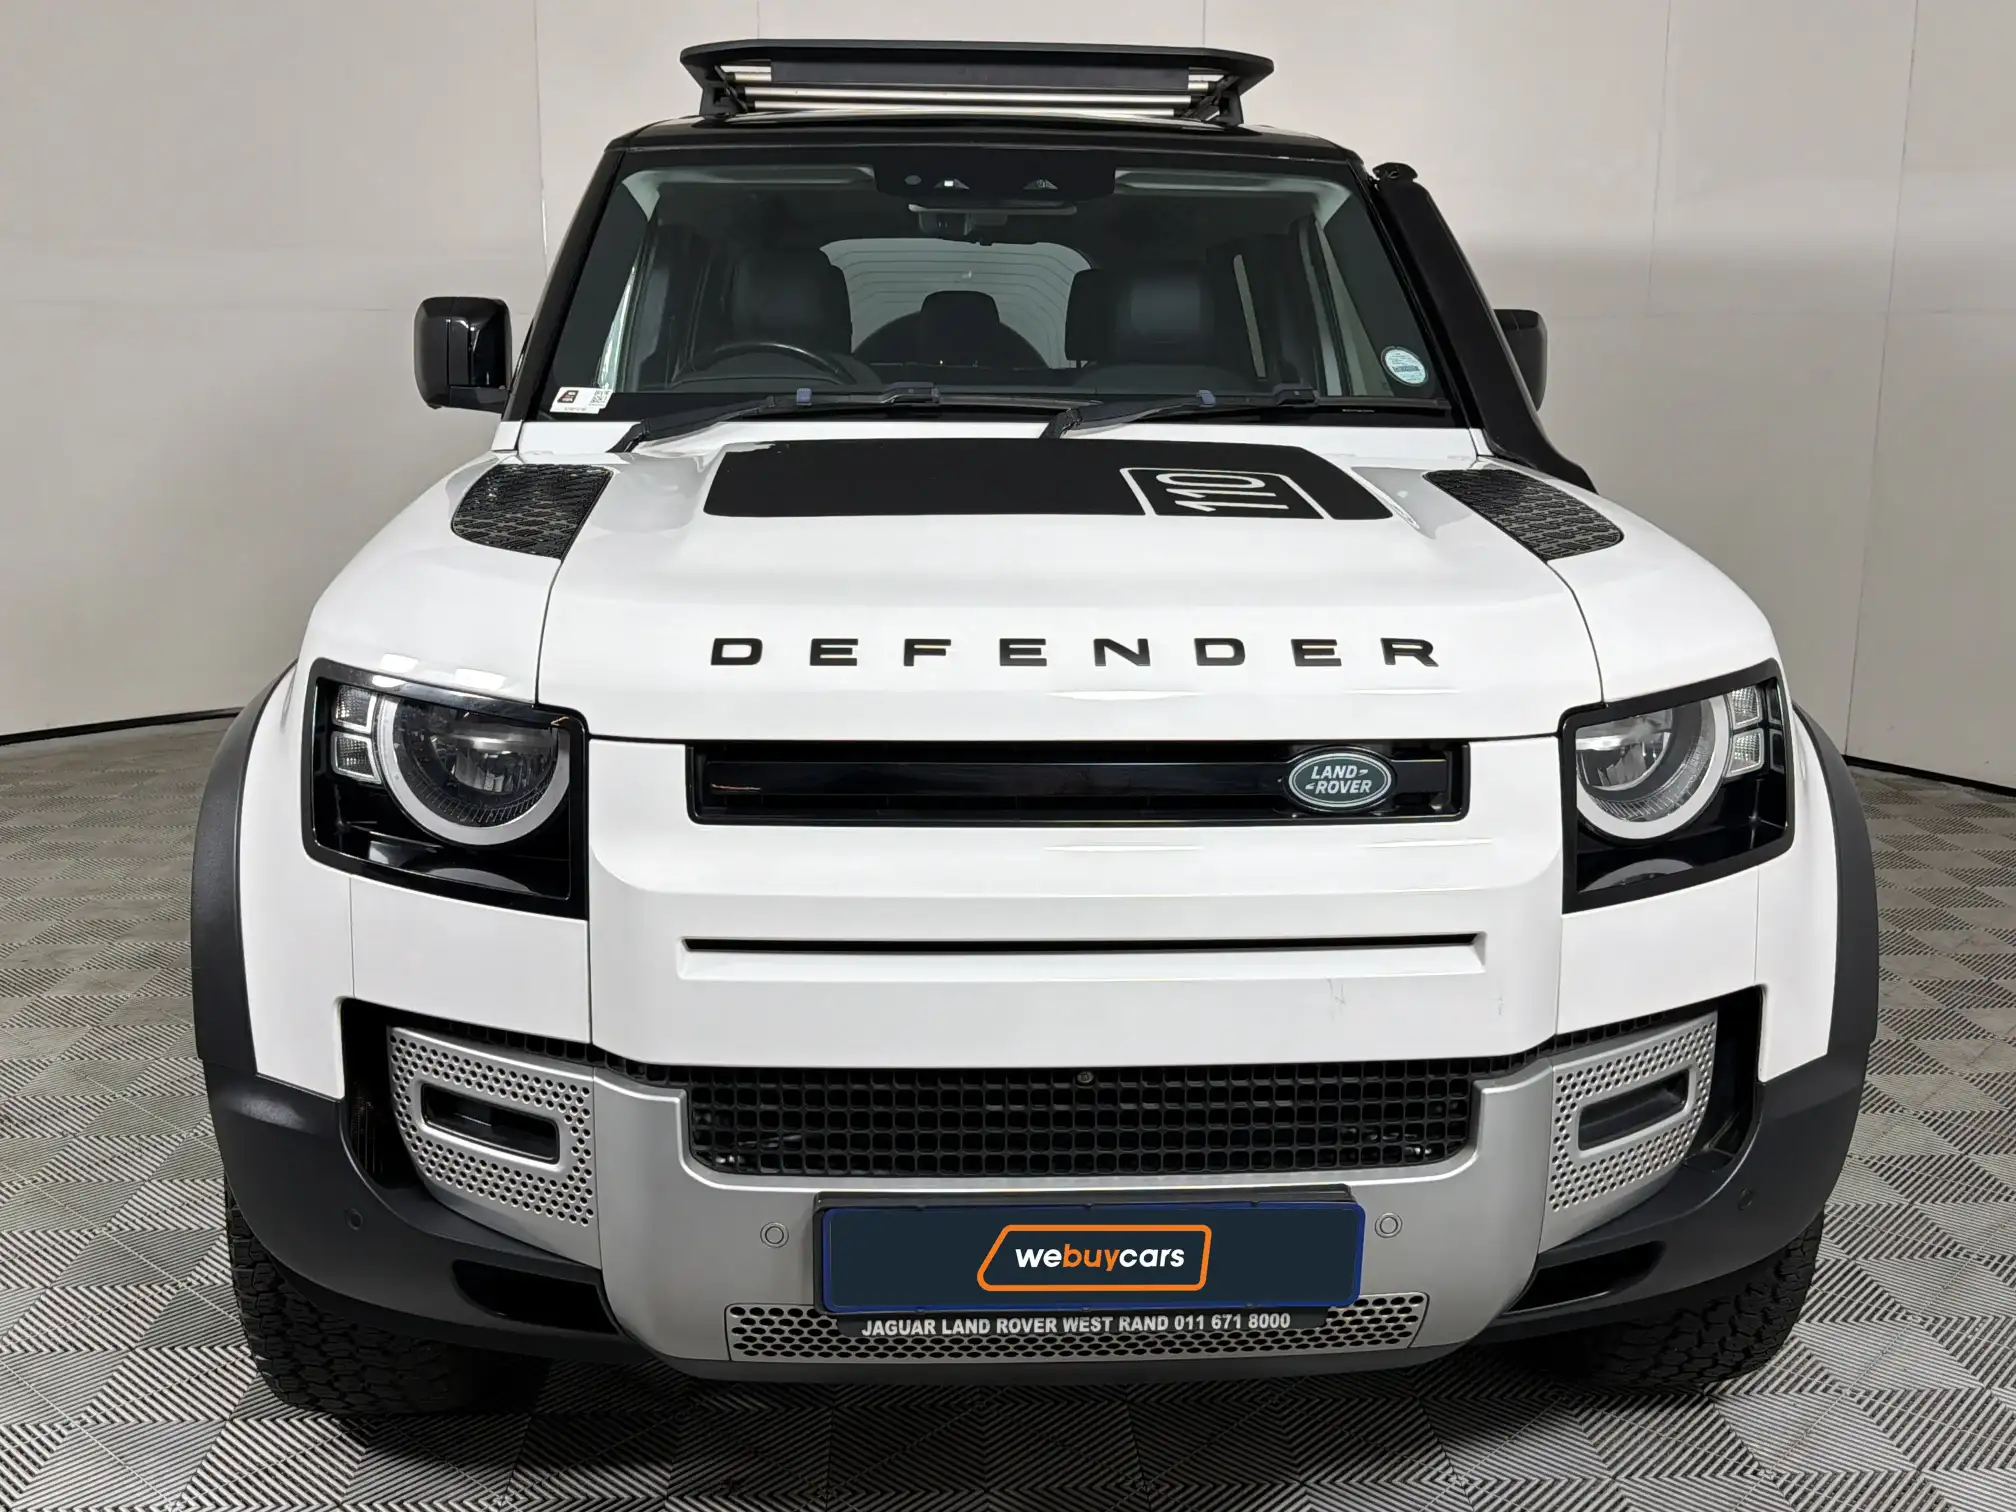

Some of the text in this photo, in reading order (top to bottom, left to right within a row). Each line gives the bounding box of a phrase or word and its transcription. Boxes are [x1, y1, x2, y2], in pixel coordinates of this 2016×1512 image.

[1155, 472, 1290, 512] 110
[710, 637, 1439, 668] DEFENDER
[1310, 765, 1358, 780] LAND
[1315, 779, 1373, 794] ROVER
[861, 1312, 1291, 1336] JAGUAR LAND ROVER WEST RAND 011 671 8000
